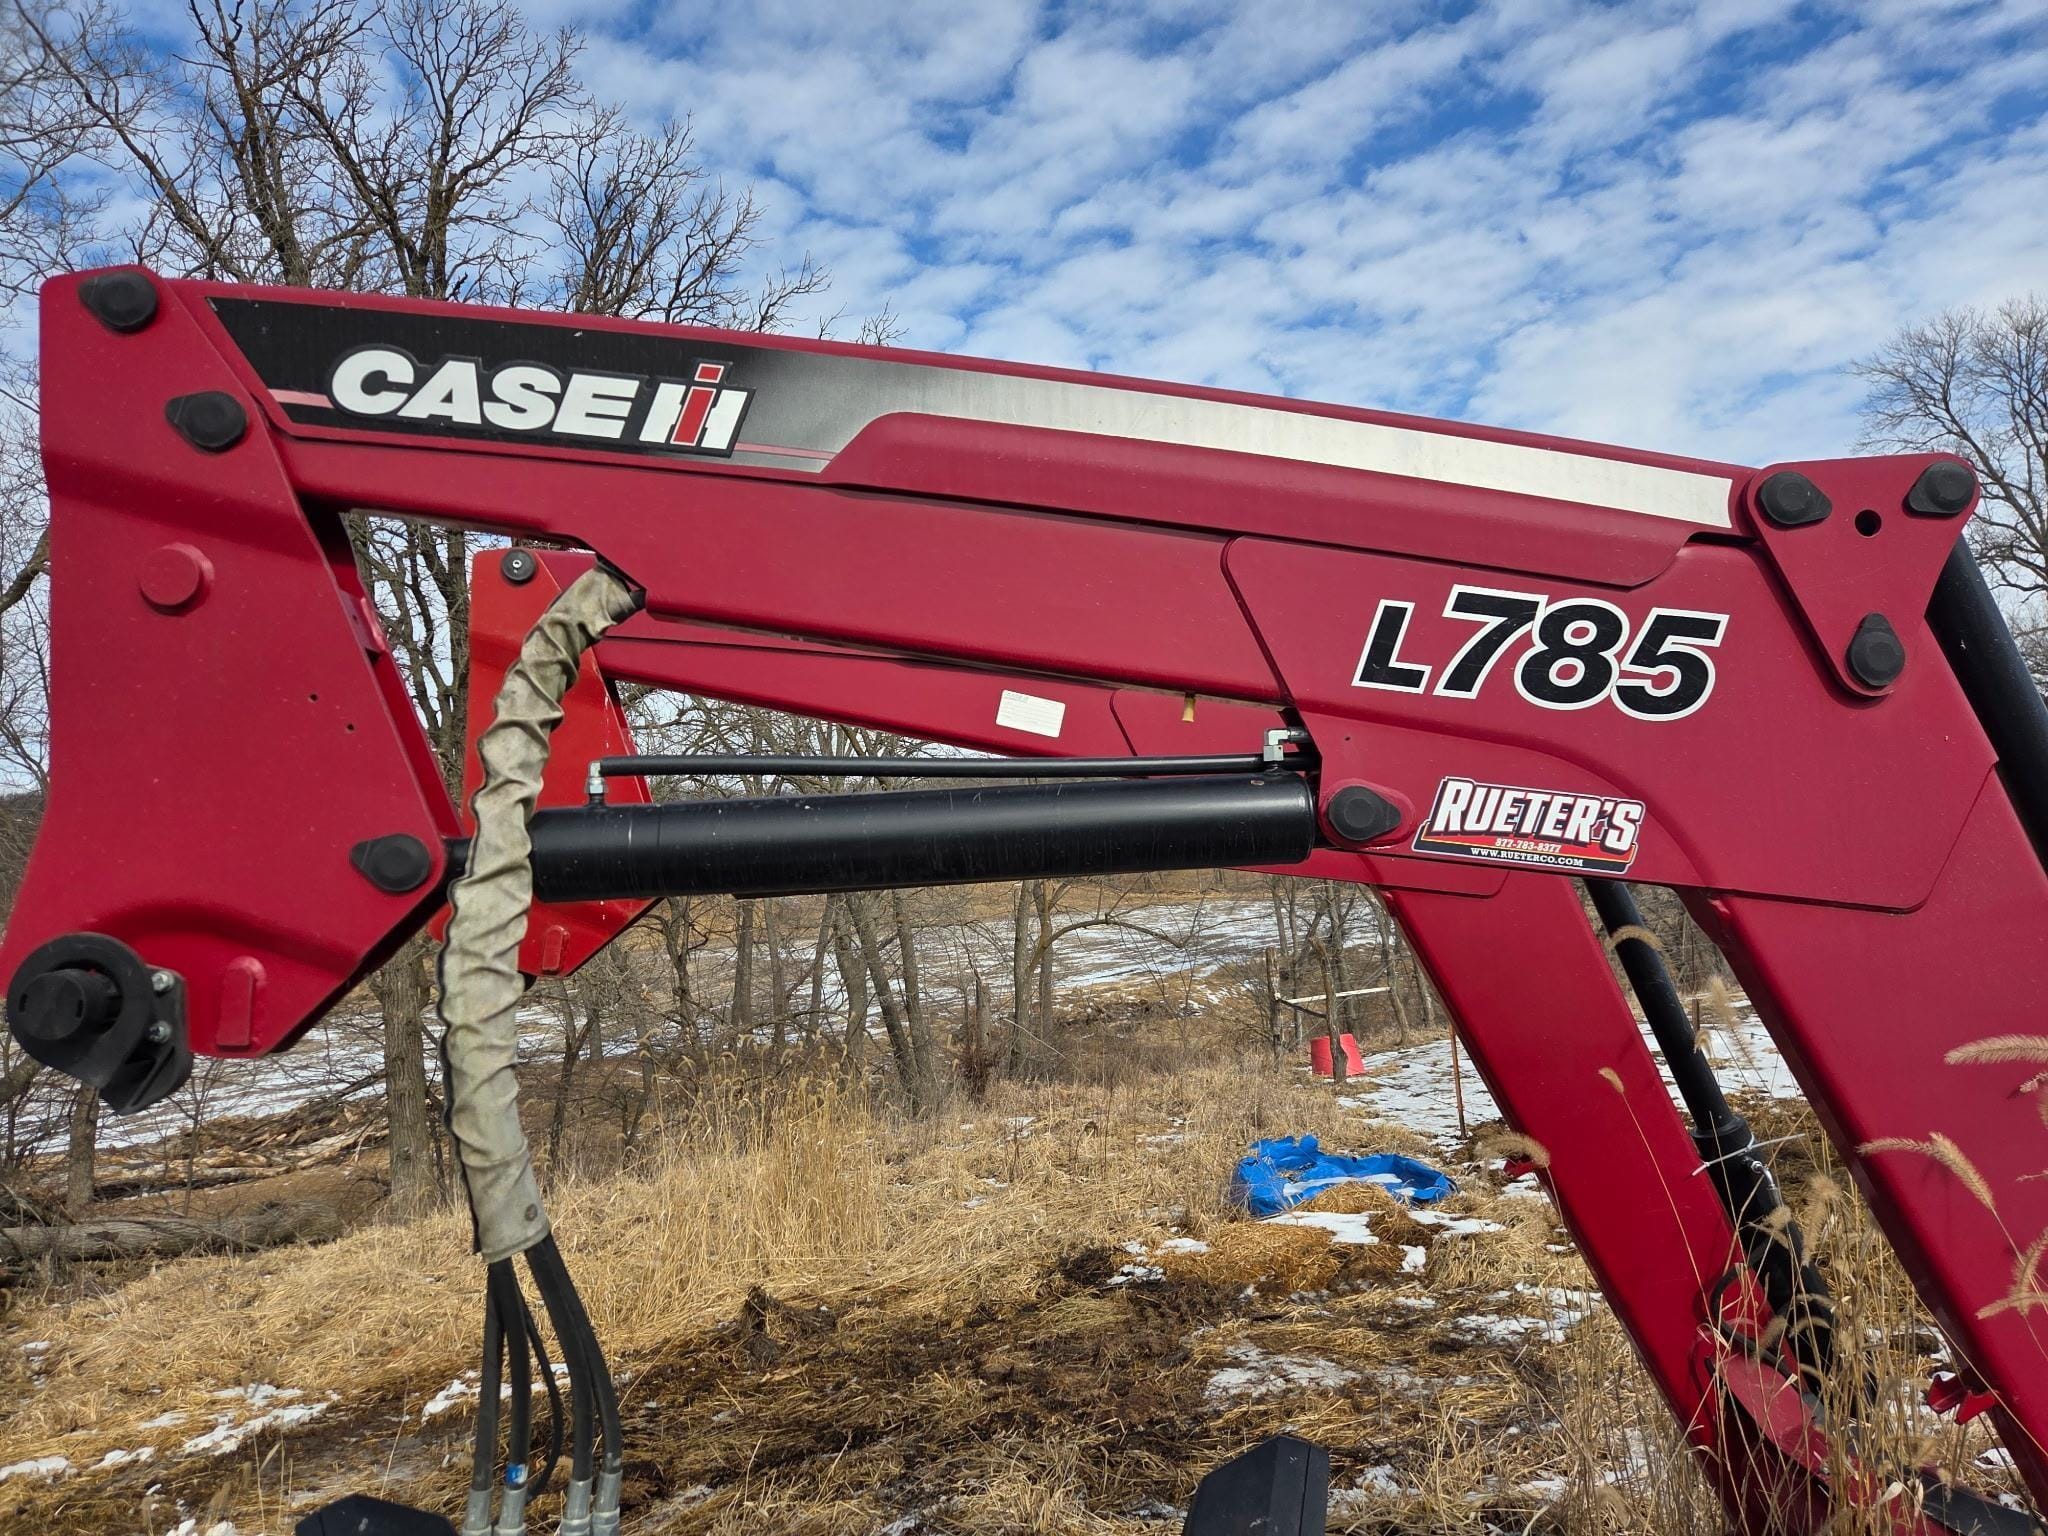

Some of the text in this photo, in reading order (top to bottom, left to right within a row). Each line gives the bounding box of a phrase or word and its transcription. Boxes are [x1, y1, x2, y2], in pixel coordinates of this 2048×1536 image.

[332, 350, 640, 439] CASE
[1351, 583, 1731, 722] L785
[1432, 779, 1644, 852] RUETER'S
[1470, 847, 1584, 868] WWW.RUETERCO.COM
